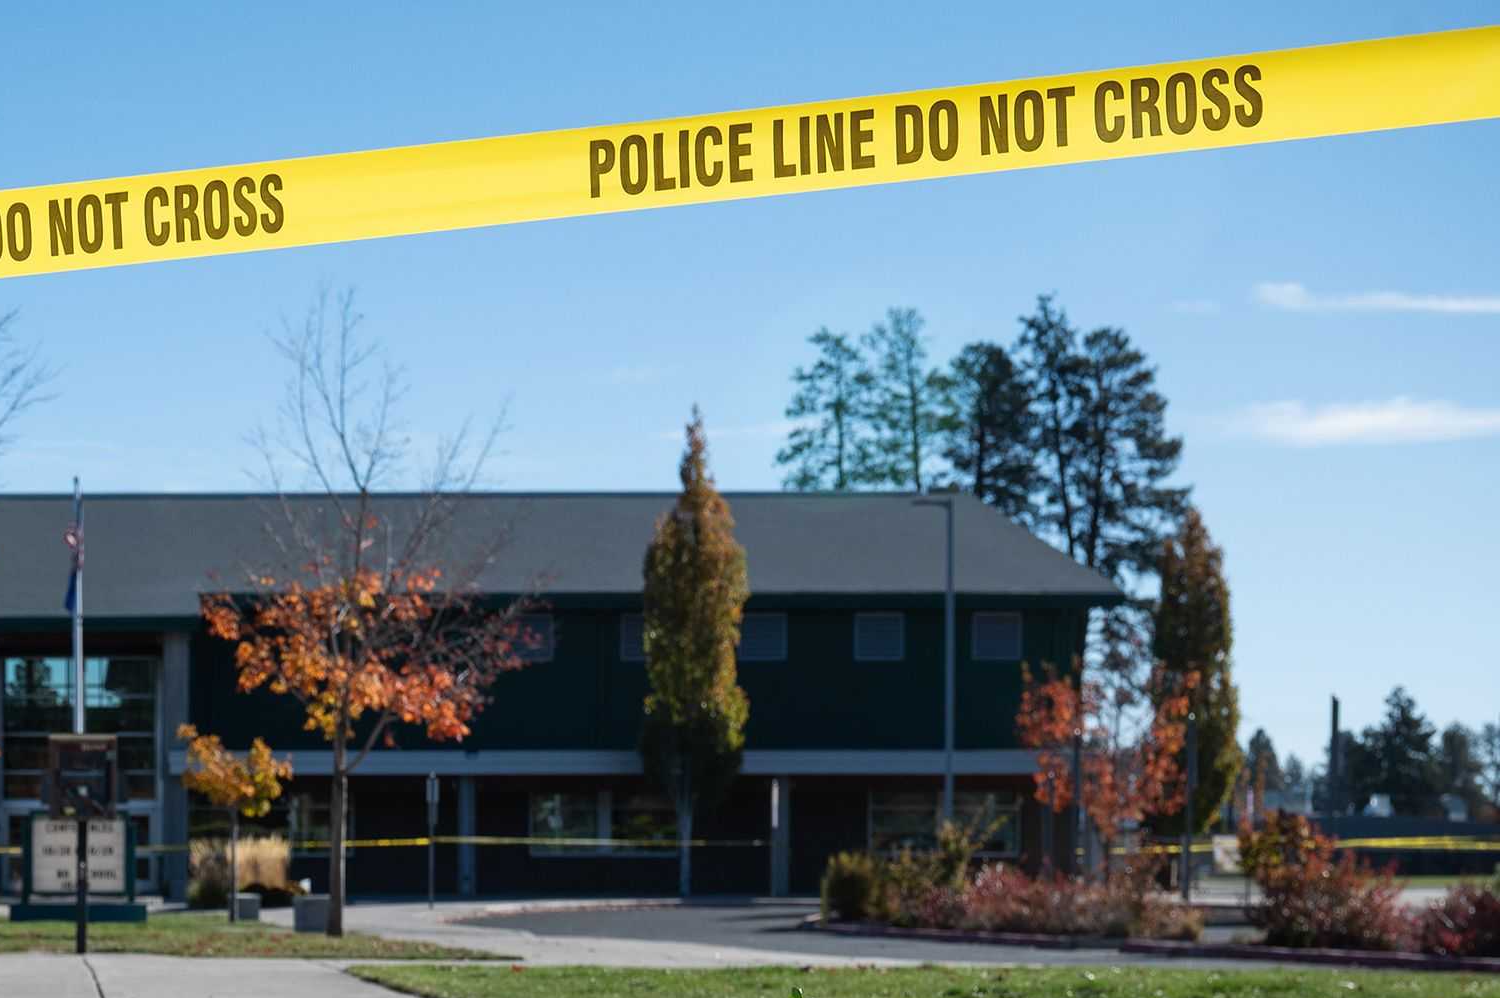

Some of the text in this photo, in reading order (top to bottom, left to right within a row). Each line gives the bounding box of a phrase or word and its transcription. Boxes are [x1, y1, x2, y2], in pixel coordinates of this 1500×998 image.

[590, 65, 1263, 198] POLICE LINE DO NOT CROSS
[49, 191, 128, 256] NOT
[144, 174, 284, 246] CROSS
